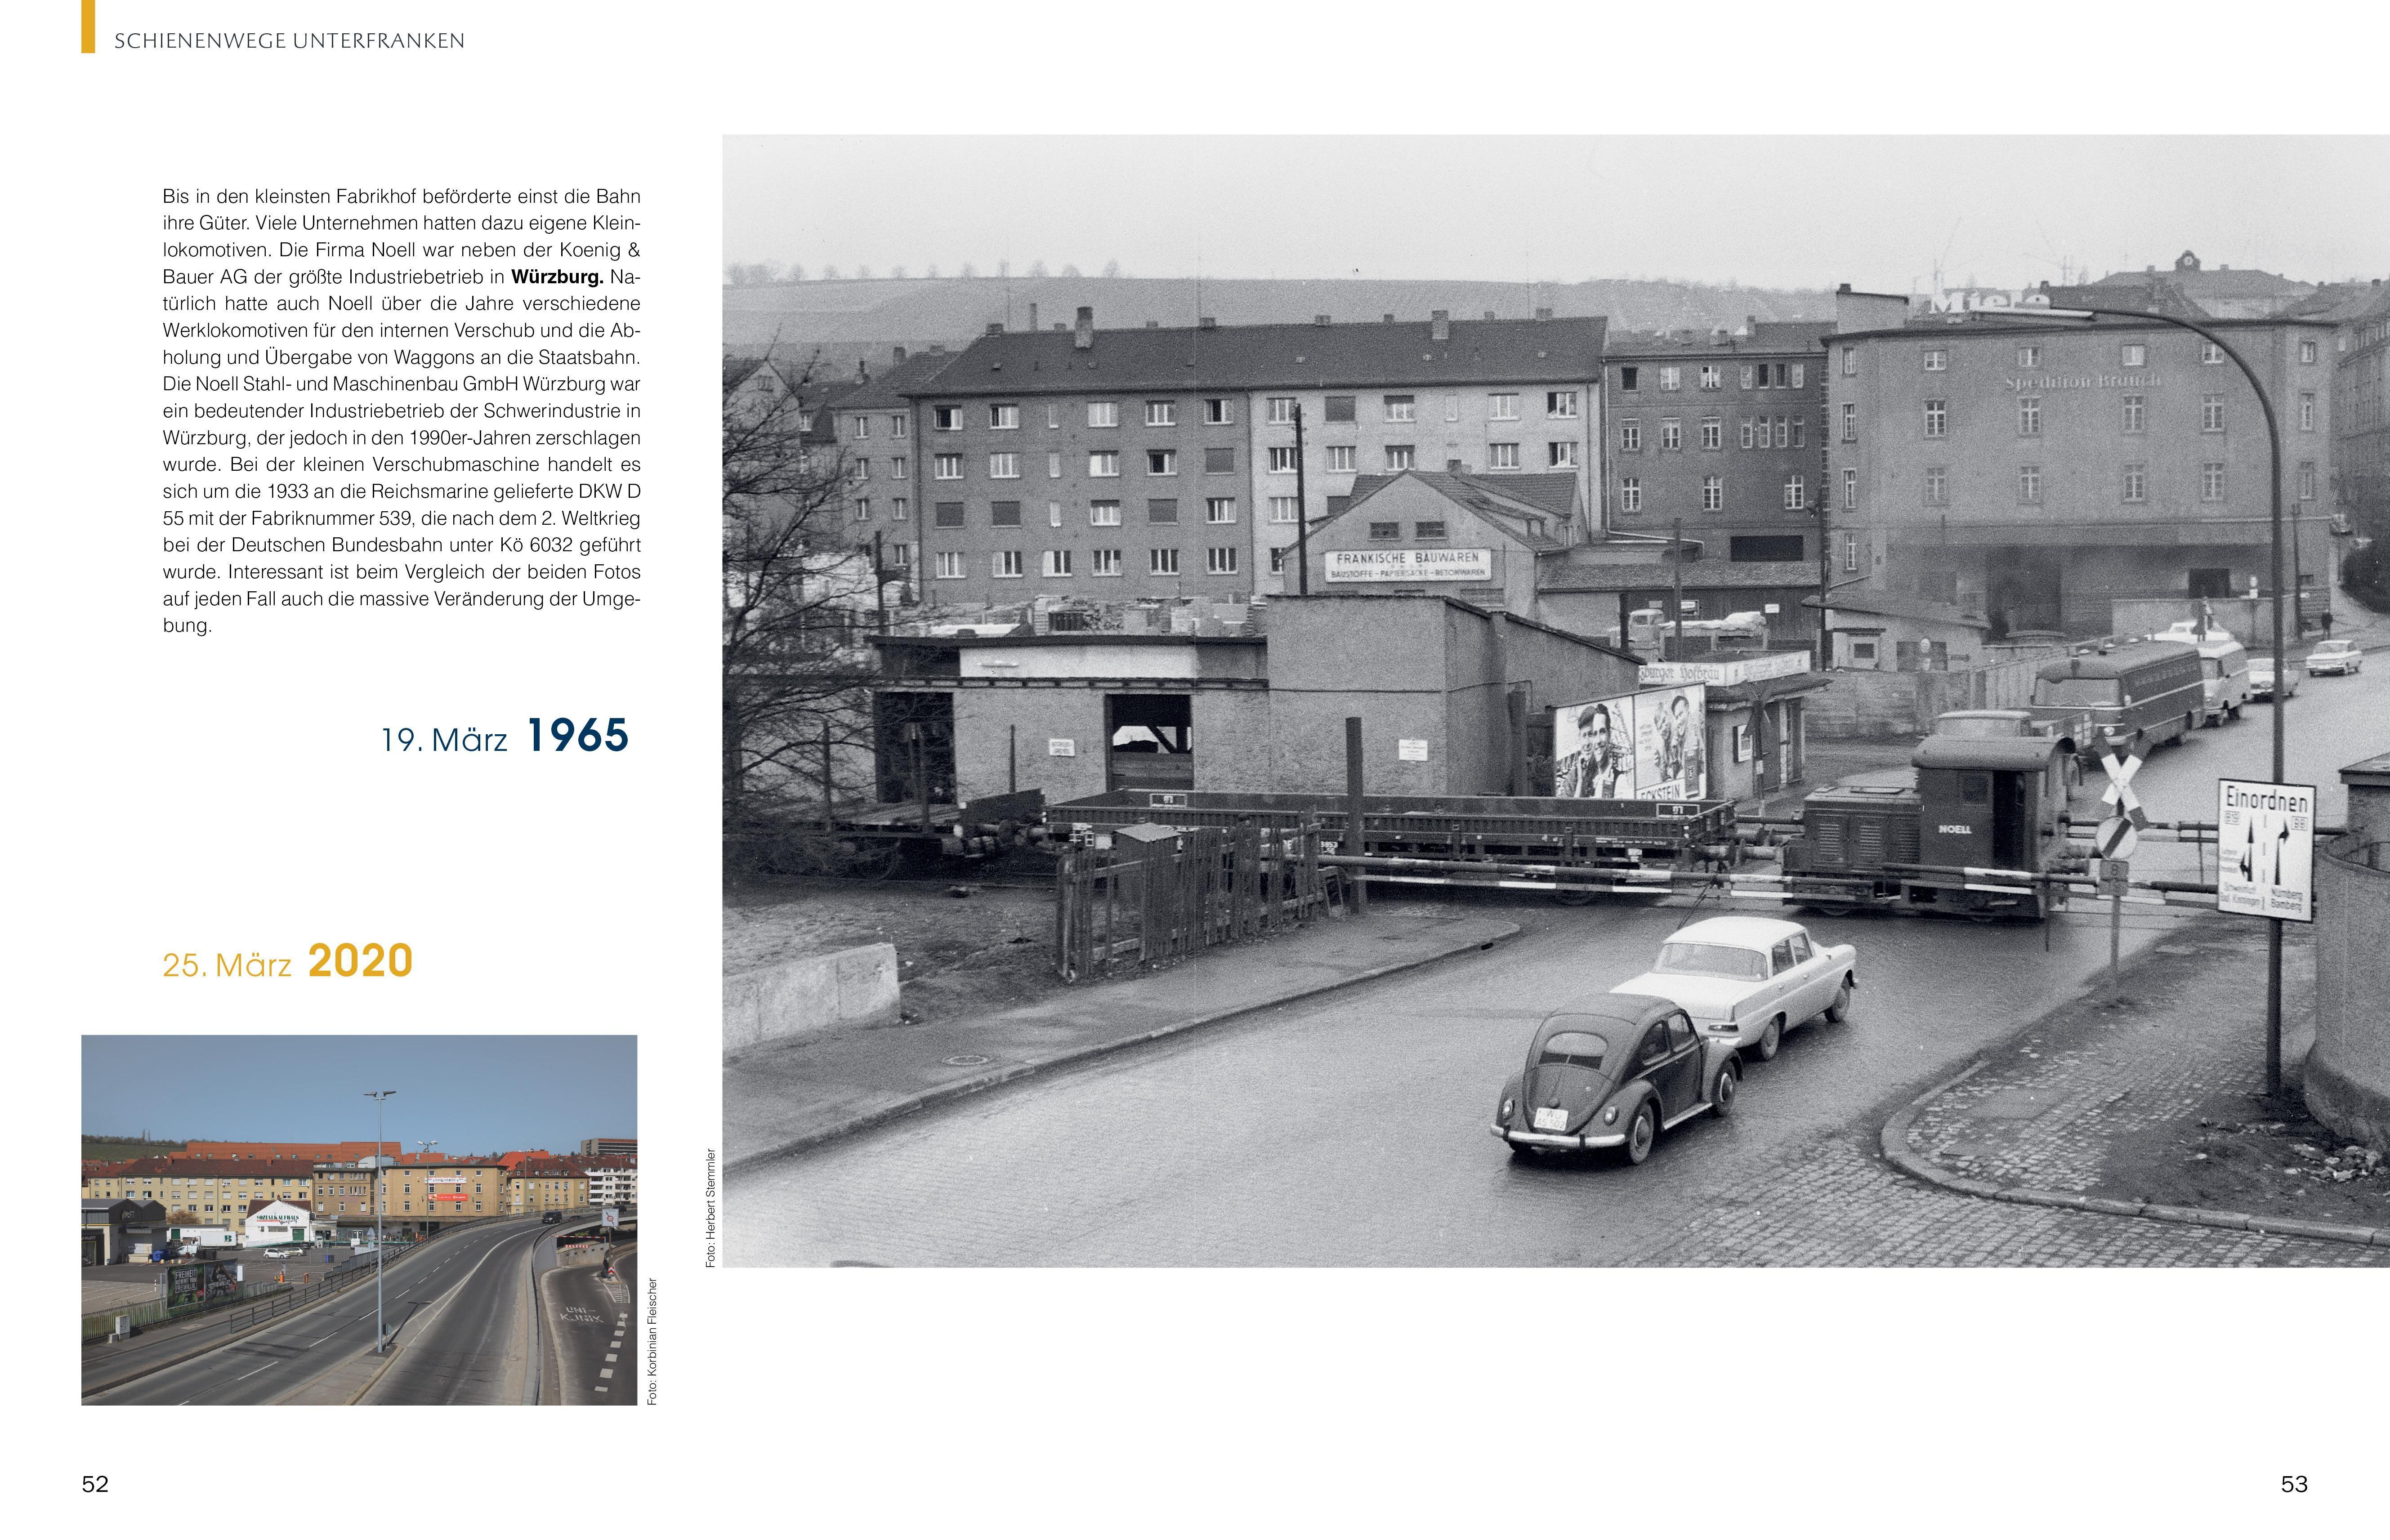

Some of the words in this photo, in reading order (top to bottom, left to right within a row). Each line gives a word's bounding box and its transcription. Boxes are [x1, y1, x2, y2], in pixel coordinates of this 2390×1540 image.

[115, 33, 286, 48] SCHIENENWEGE
[295, 33, 463, 48] UNTERFRANKEN
[164, 189, 188, 203] Bis
[197, 189, 209, 203] in
[217, 189, 248, 203] den
[256, 189, 330, 203] kleinsten
[338, 188, 416, 203] Fabrikhof
[424, 188, 511, 203] beförderte
[518, 189, 558, 203] einst
[565, 189, 590, 203] die
[598, 189, 640, 203] Bahn
[164, 215, 194, 230] ihre
[200, 215, 249, 230] Güter.
[256, 215, 296, 230] Viele
[304, 215, 417, 230] Unternehmen
[424, 215, 475, 230] hatten
[482, 215, 523, 230] dazu
[530, 215, 586, 234] eigene
[594, 215, 640, 230] Klein-
[164, 242, 271, 257] lokomotiven.
[281, 242, 308, 257] Die
[317, 242, 364, 257] Firma
[373, 242, 414, 257] Noell
[423, 246, 454, 257] war
[462, 242, 515, 257] neben
[524, 242, 552, 257] der
[561, 242, 620, 261] Koenig
[629, 242, 640, 257] &
[164, 269, 214, 284] Bauer
[220, 269, 246, 284] AG
[255, 269, 282, 284] der
[290, 269, 342, 288] größte
[350, 269, 483, 284] Industriebetrieb
[491, 269, 504, 283] in
[511, 269, 603, 287] Würzburg.
[612, 269, 640, 284] Na-
[163, 323, 307, 337] Werklokomotiven
[314, 322, 335, 337] für
[342, 323, 373, 337] den
[381, 323, 448, 337] internen
[455, 323, 534, 337] Verschub
[541, 323, 572, 337] und
[579, 323, 604, 337] die
[611, 323, 640, 337] Ab-
[164, 350, 220, 368] holung
[228, 350, 259, 364] und
[266, 347, 352, 368] Übergabe
[358, 353, 387, 364] von
[394, 350, 474, 368] Waggons
[481, 353, 500, 364] an
[508, 350, 533, 364] die
[539, 349, 639, 364] Staatsbahn.
[164, 403, 188, 418] ein
[195, 403, 304, 418] bedeutender
[311, 403, 444, 418] Industriebetrieb
[451, 403, 478, 418] der
[484, 403, 620, 418] Schwerindustrie
[627, 403, 640, 417] in
[163, 430, 250, 449] Würzburg,
[257, 430, 285, 445] der
[289, 430, 347, 448] jedoch
[353, 430, 366, 444] in
[372, 430, 403, 445] den
[411, 430, 530, 445] 1990er-Jahren
[536, 430, 640, 449] zerschlagen
[163, 457, 220, 471] wurde.
[232, 457, 257, 471] Bei
[267, 457, 295, 471] der
[304, 457, 363, 471] kleinen
[373, 457, 539, 471] Verschubmaschine
[549, 457, 612, 471] handelt
[621, 460, 640, 471] es
[164, 511, 183, 525] 55
[190, 511, 214, 525] mit
[219, 511, 246, 525] der
[253, 511, 375, 525] Fabriknummer
[380, 511, 414, 527] 539,
[422, 511, 447, 525] die
[453, 511, 493, 525] nach
[500, 511, 536, 525] dem
[542, 511, 555, 525] 2.
[562, 511, 639, 529] Weltkrieg
[164, 537, 188, 552] bei
[197, 537, 225, 552] der
[233, 537, 324, 552] Deutschen
[333, 537, 442, 552] Bundesbahn
[451, 539, 493, 552] unter
[501, 537, 523, 552] Kö
[531, 537, 572, 552] 6032
[580, 537, 641, 556] geführt
[1416, 553, 1479, 563] BAUWAREN
[164, 591, 189, 606] auf
[194, 591, 241, 609] jeden
[248, 591, 275, 606] Fall
[282, 591, 322, 606] auch
[329, 591, 354, 606] die
[361, 591, 429, 606] massive
[434, 591, 543, 610] Veränderung
[550, 591, 577, 606] der
[584, 591, 640, 610] Umge-
[164, 618, 211, 636] bung.
[383, 728, 421, 751] 19.
[434, 728, 507, 751] März
[530, 718, 628, 751] 1965
[1641, 784, 1680, 799] ECKSTEIN
[2226, 785, 2308, 812] Einordnen
[1938, 825, 1973, 834] NOELL
[164, 953, 205, 977] 25.
[218, 953, 291, 977] März
[309, 943, 411, 977] 2020
[706, 1149, 715, 1197] Stemmler
[706, 1201, 715, 1239] Herbert
[706, 1243, 715, 1267] Foto:
[176, 1269, 197, 1279] FREIHEIT
[176, 1283, 197, 1292] FREIWILLIG.
[648, 1278, 656, 1324] Fleischer
[648, 1328, 656, 1375] Korbinian
[648, 1381, 656, 1405] Foto:
[83, 1476, 108, 1492] 52
[2282, 1476, 2307, 1492] 53
